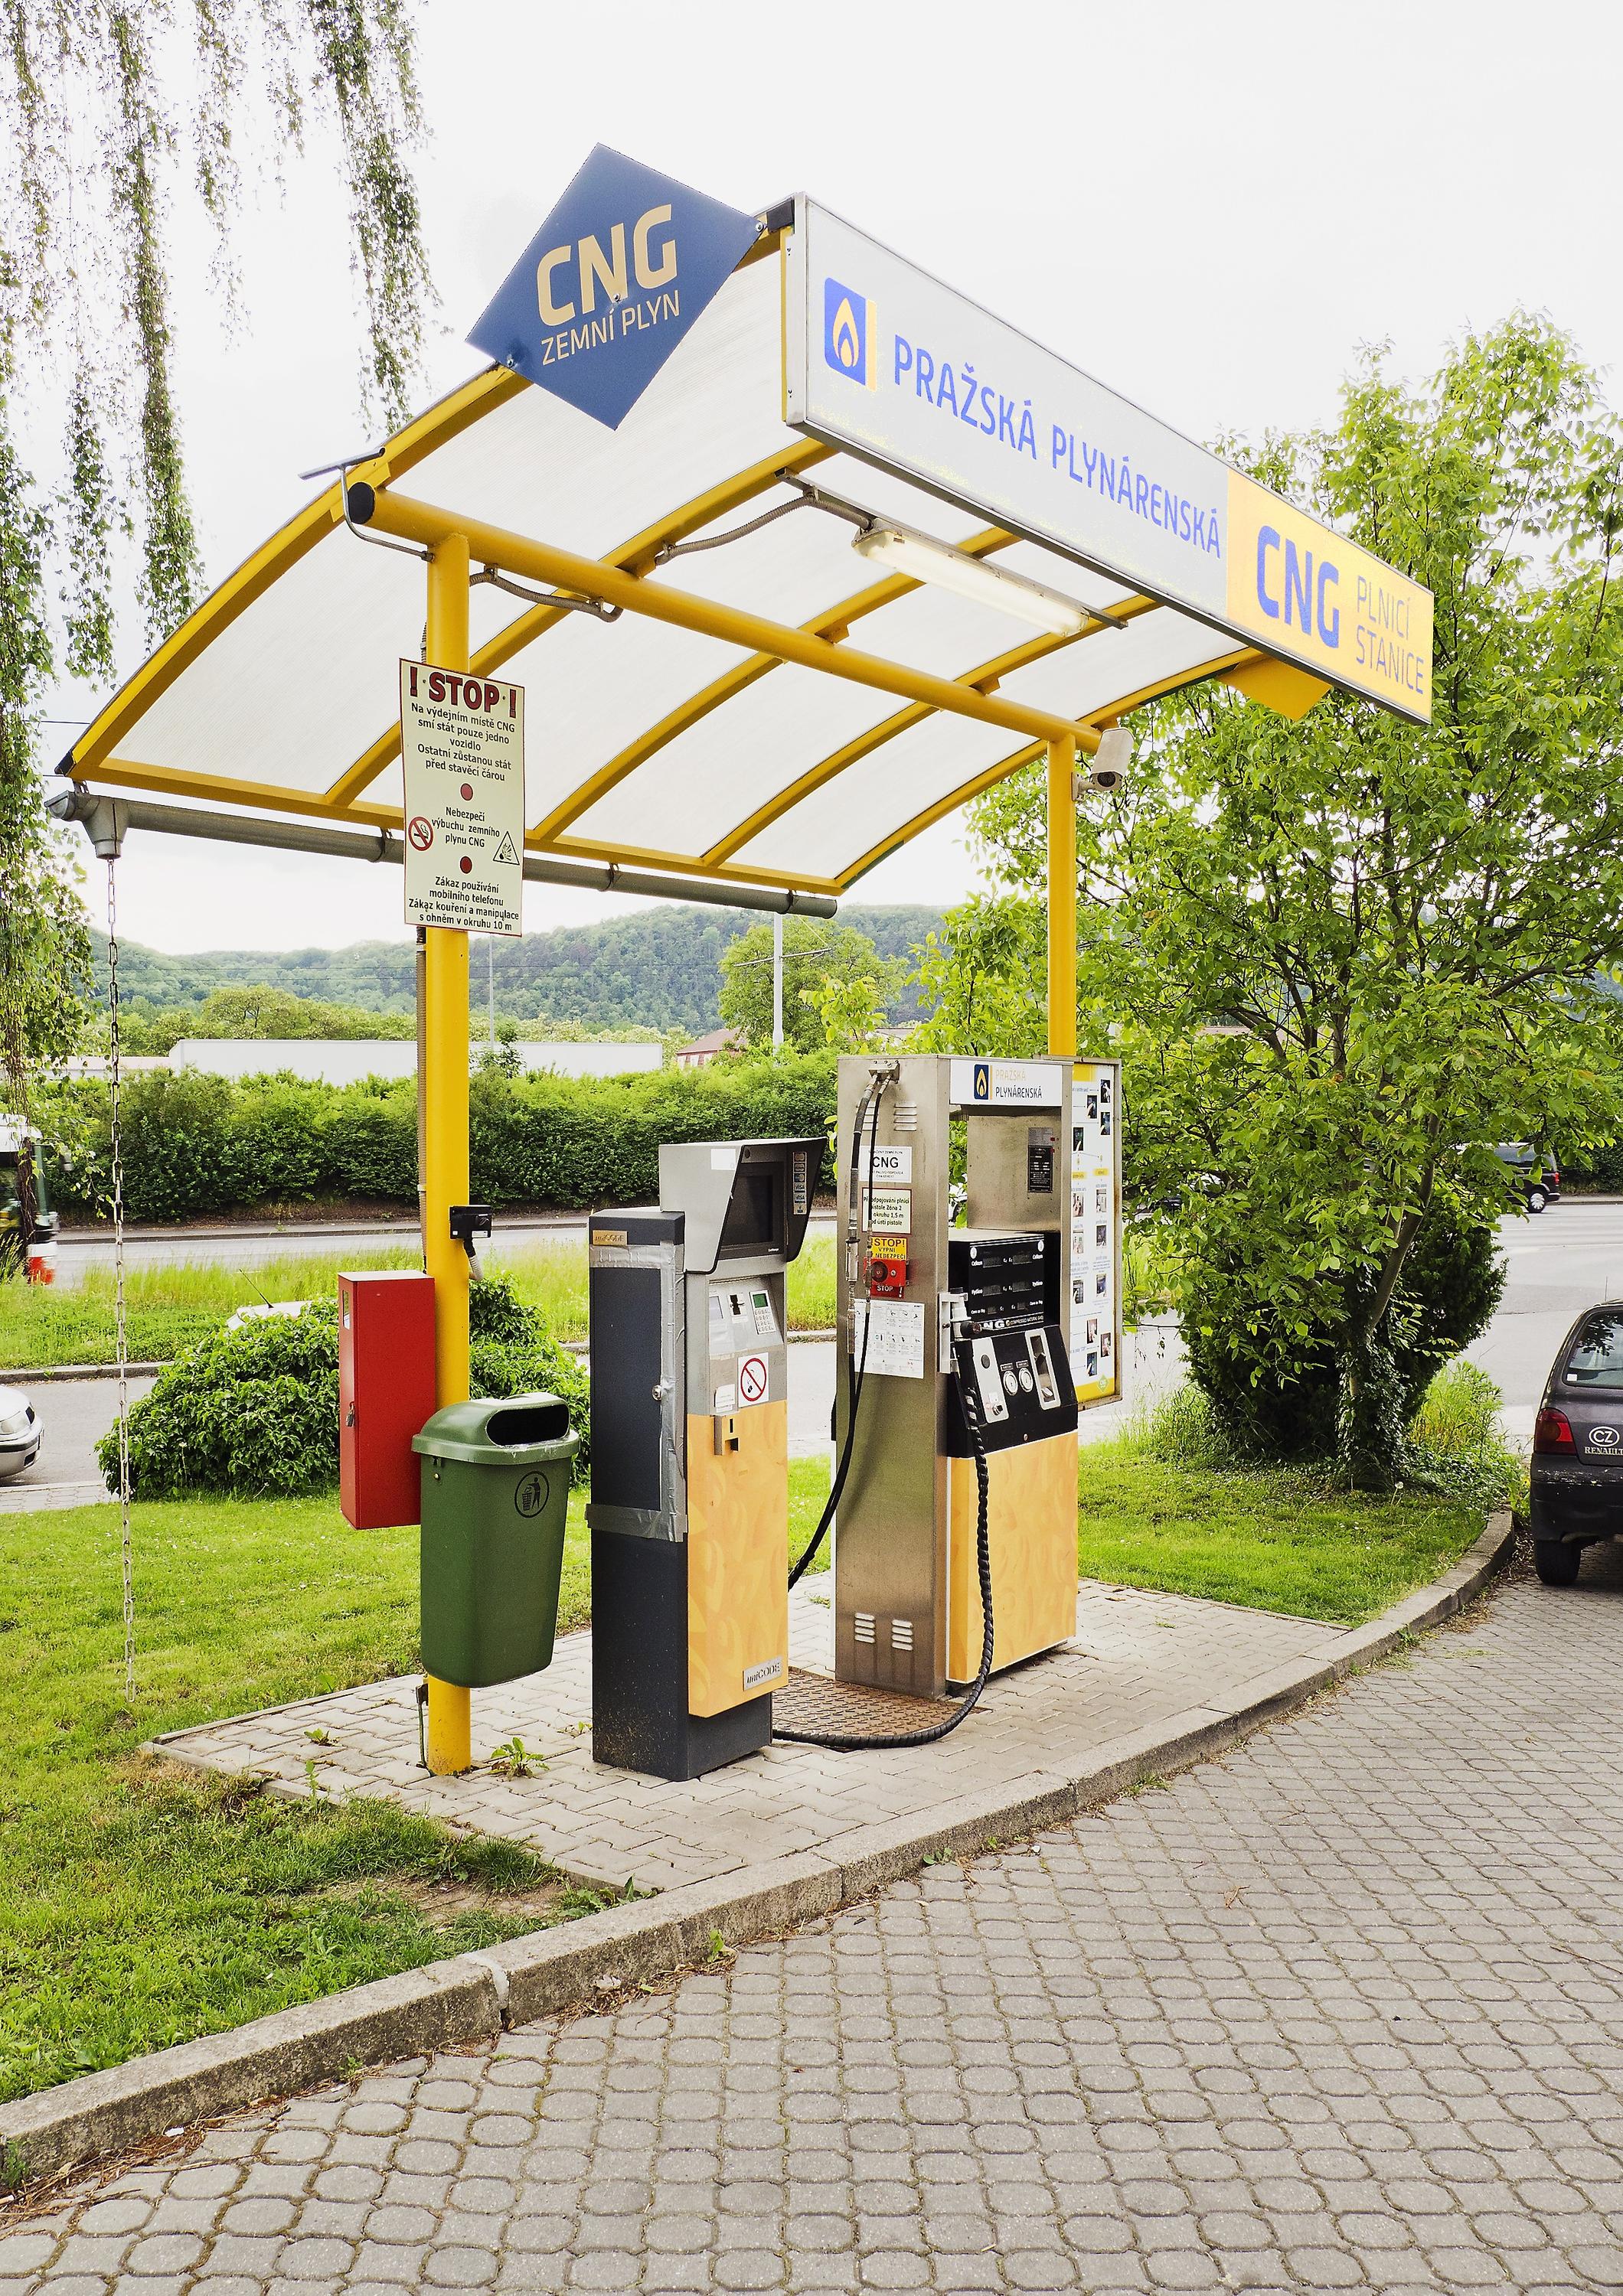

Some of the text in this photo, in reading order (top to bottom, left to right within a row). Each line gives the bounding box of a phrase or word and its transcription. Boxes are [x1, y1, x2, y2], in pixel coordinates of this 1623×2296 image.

[537, 204, 678, 326] CNG
[541, 289, 680, 366] ZEMNÍ PLYN
[894, 334, 1220, 559] PRAŽSKÁ PLYNÁRENSKÁ
[1256, 525, 1339, 649] CNG
[1357, 575, 1411, 641] PLNICÍ
[1357, 625, 1424, 695] STANICE
[429, 671, 500, 713] STOP
[411, 702, 515, 732] Na výdejním místě CNG
[418, 719, 509, 745] smí stát pouze jedno
[449, 738, 482, 752] vozidlo
[417, 743, 511, 770] Ostatní zůstanou stát
[426, 757, 505, 781] před stavěcí čárou
[446, 806, 485, 822] Nebezpečí
[431, 817, 500, 838] výbuchu zemního
[445, 833, 485, 848] plynu CNG
[435, 876, 499, 894] Zákaz používání
[429, 889, 504, 906] mobilního telefonu
[408, 898, 433, 910] Zákaz
[436, 900, 467, 914] kouření
[476, 907, 519, 921] manipulace
[426, 913, 454, 925] ohněm
[463, 917, 491, 928] okruhu
[493, 920, 503, 930] 10
[505, 923, 512, 931] m
[995, 1068, 1026, 1081] PRAŽSKÁ
[995, 1084, 1043, 1099] PLYNÁRENSKÁ
[872, 1156, 899, 1168] CNG
[983, 1319, 1005, 1329] NG
[1593, 1430, 1613, 1443] CZ
[1585, 1446, 1623, 1456] RENAULT
[746, 1662, 781, 1684] uniCODE
